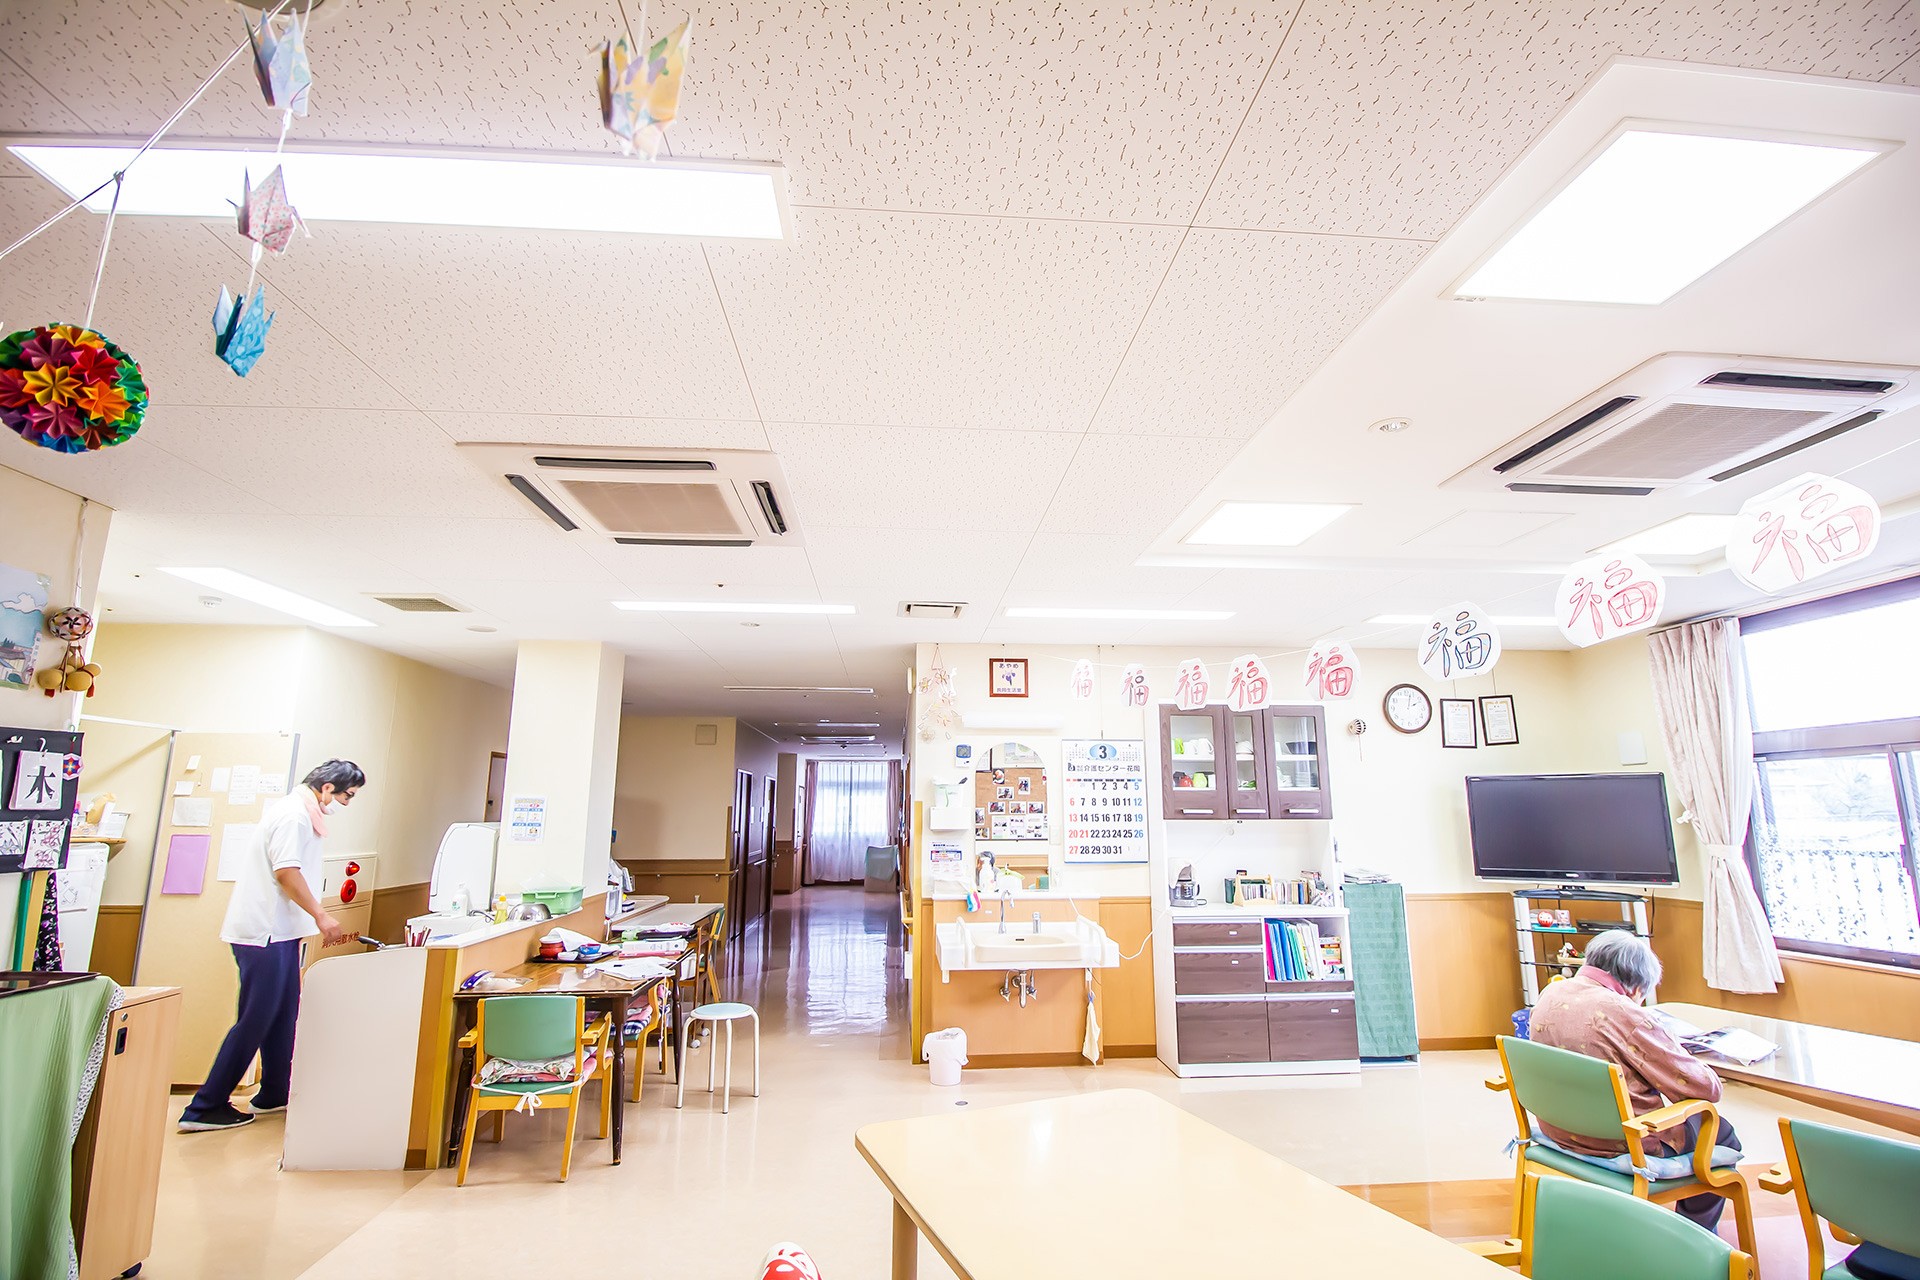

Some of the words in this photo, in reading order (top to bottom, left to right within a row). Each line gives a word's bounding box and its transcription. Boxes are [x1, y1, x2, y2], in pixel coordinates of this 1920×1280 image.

[1752, 485, 1874, 582] 福
[1568, 560, 1658, 639] 福
[1423, 611, 1492, 677] 福
[1072, 665, 1092, 698] 福
[1122, 670, 1150, 706] 福
[1174, 665, 1208, 708] 福
[1226, 660, 1268, 709] 福
[1305, 646, 1354, 700] 福
[1099, 745, 1107, 759] 3
[25, 766, 56, 803] 木
[1070, 798, 1075, 806] 6
[1081, 798, 1085, 806] 7
[1092, 798, 1096, 806] 8
[1102, 798, 1107, 806] 9
[1112, 798, 1120, 806] 10
[1123, 798, 1131, 806] 11
[1134, 798, 1142, 806] 12
[1102, 782, 1107, 790] 2
[1113, 782, 1117, 790] 3
[1134, 782, 1139, 790] 5
[1069, 814, 1077, 822] 13
[1080, 814, 1088, 822] 14
[1091, 814, 1099, 822] 15
[1102, 814, 1110, 822] 16
[1112, 814, 1121, 822] 17
[1123, 813, 1132, 822] 18
[1134, 814, 1143, 822] 19
[1069, 830, 1078, 838] 20
[1079, 830, 1088, 838] 21
[1090, 830, 1100, 838] 22
[1101, 830, 1111, 838] 23
[1112, 829, 1122, 838] 24
[1123, 829, 1133, 838] 25
[1134, 830, 1144, 838] 26
[1069, 846, 1078, 854] 27
[1080, 846, 1090, 854] 28
[1091, 846, 1101, 854] 29
[1102, 846, 1111, 854] 30
[1113, 846, 1122, 854] 31
